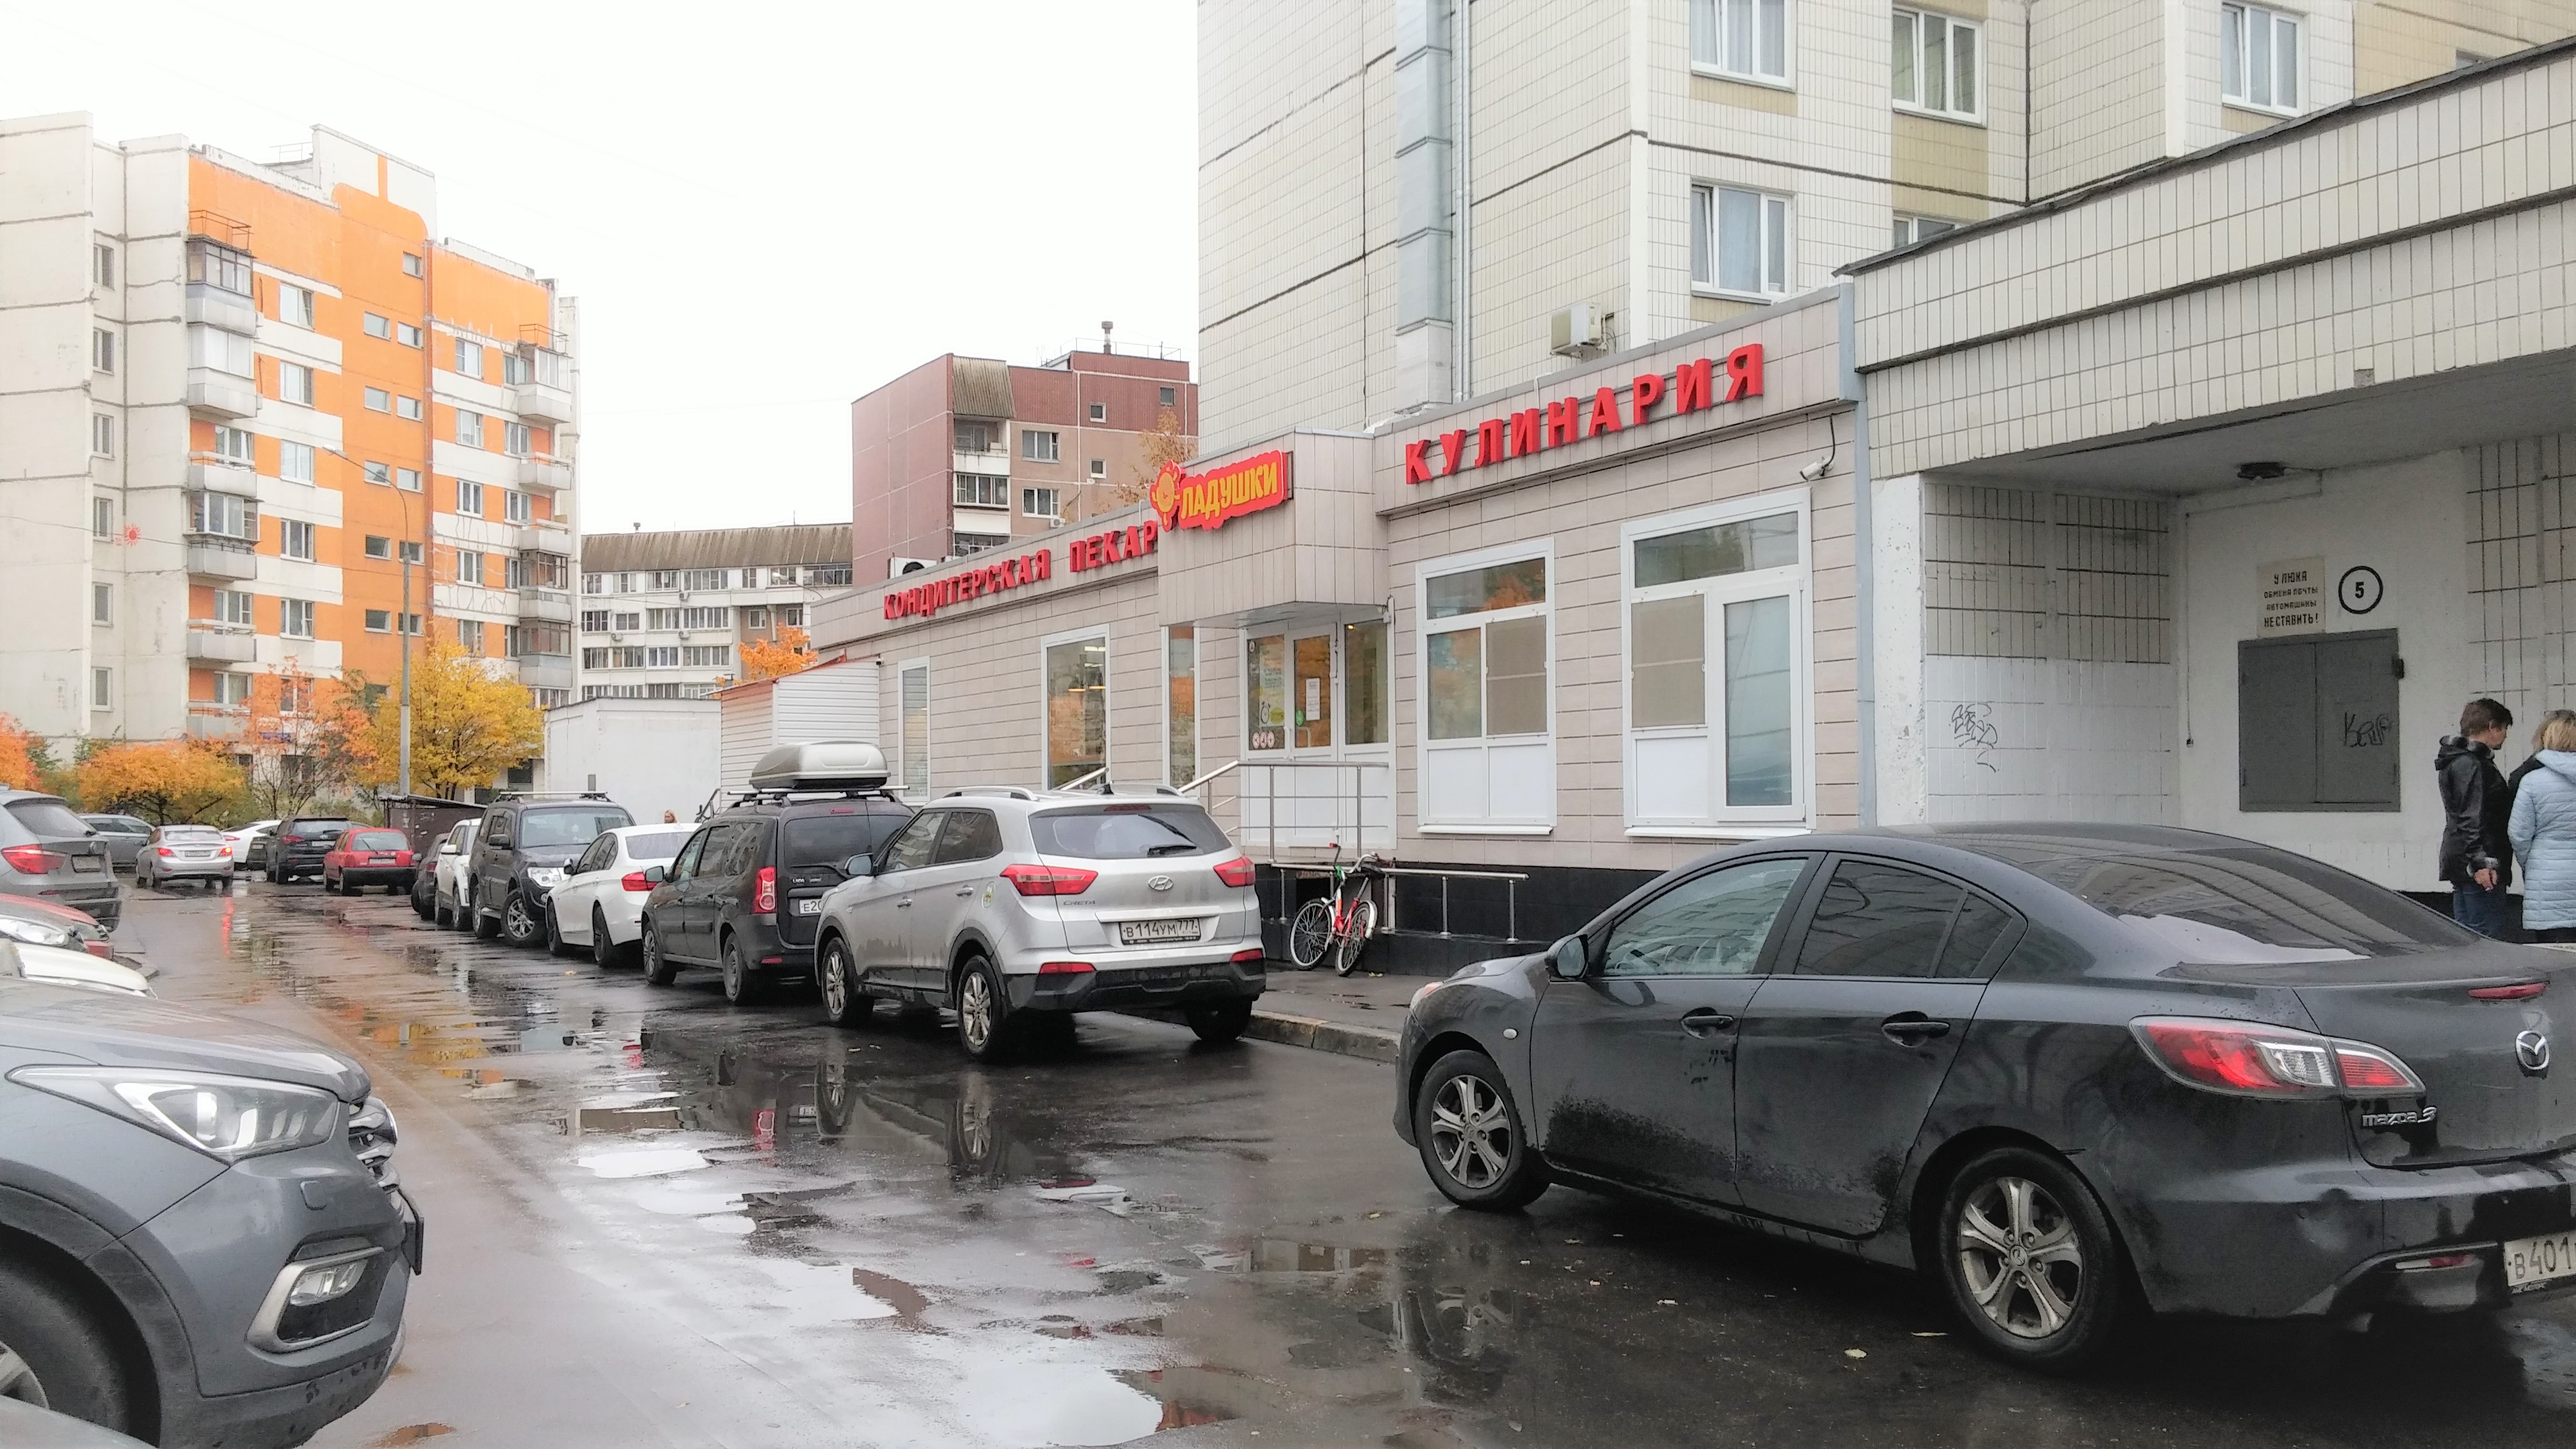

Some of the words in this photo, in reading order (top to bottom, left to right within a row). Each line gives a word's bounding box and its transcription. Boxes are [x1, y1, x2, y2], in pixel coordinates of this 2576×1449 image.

[1406, 344, 1764, 485] КУЛИНАРИЯ
[1181, 461, 1277, 520] ЛАДУШКИ
[884, 549, 1051, 620] КОНДИТЕРСКАЯ
[2274, 573, 2279, 585] У
[2282, 571, 2307, 583] ЛЮКА
[2264, 589, 2291, 599] ОБМЕНА
[2293, 586, 2318, 595] ПОЧТЫ
[2355, 581, 2364, 599] 5
[2266, 600, 2317, 611] АВТОМАШИНЫ
[1177, 920, 1194, 930] 777
[2362, 1112, 2417, 1126] mazda
[2417, 1107, 2437, 1123] 3
[2514, 1236, 2576, 1279] В401
